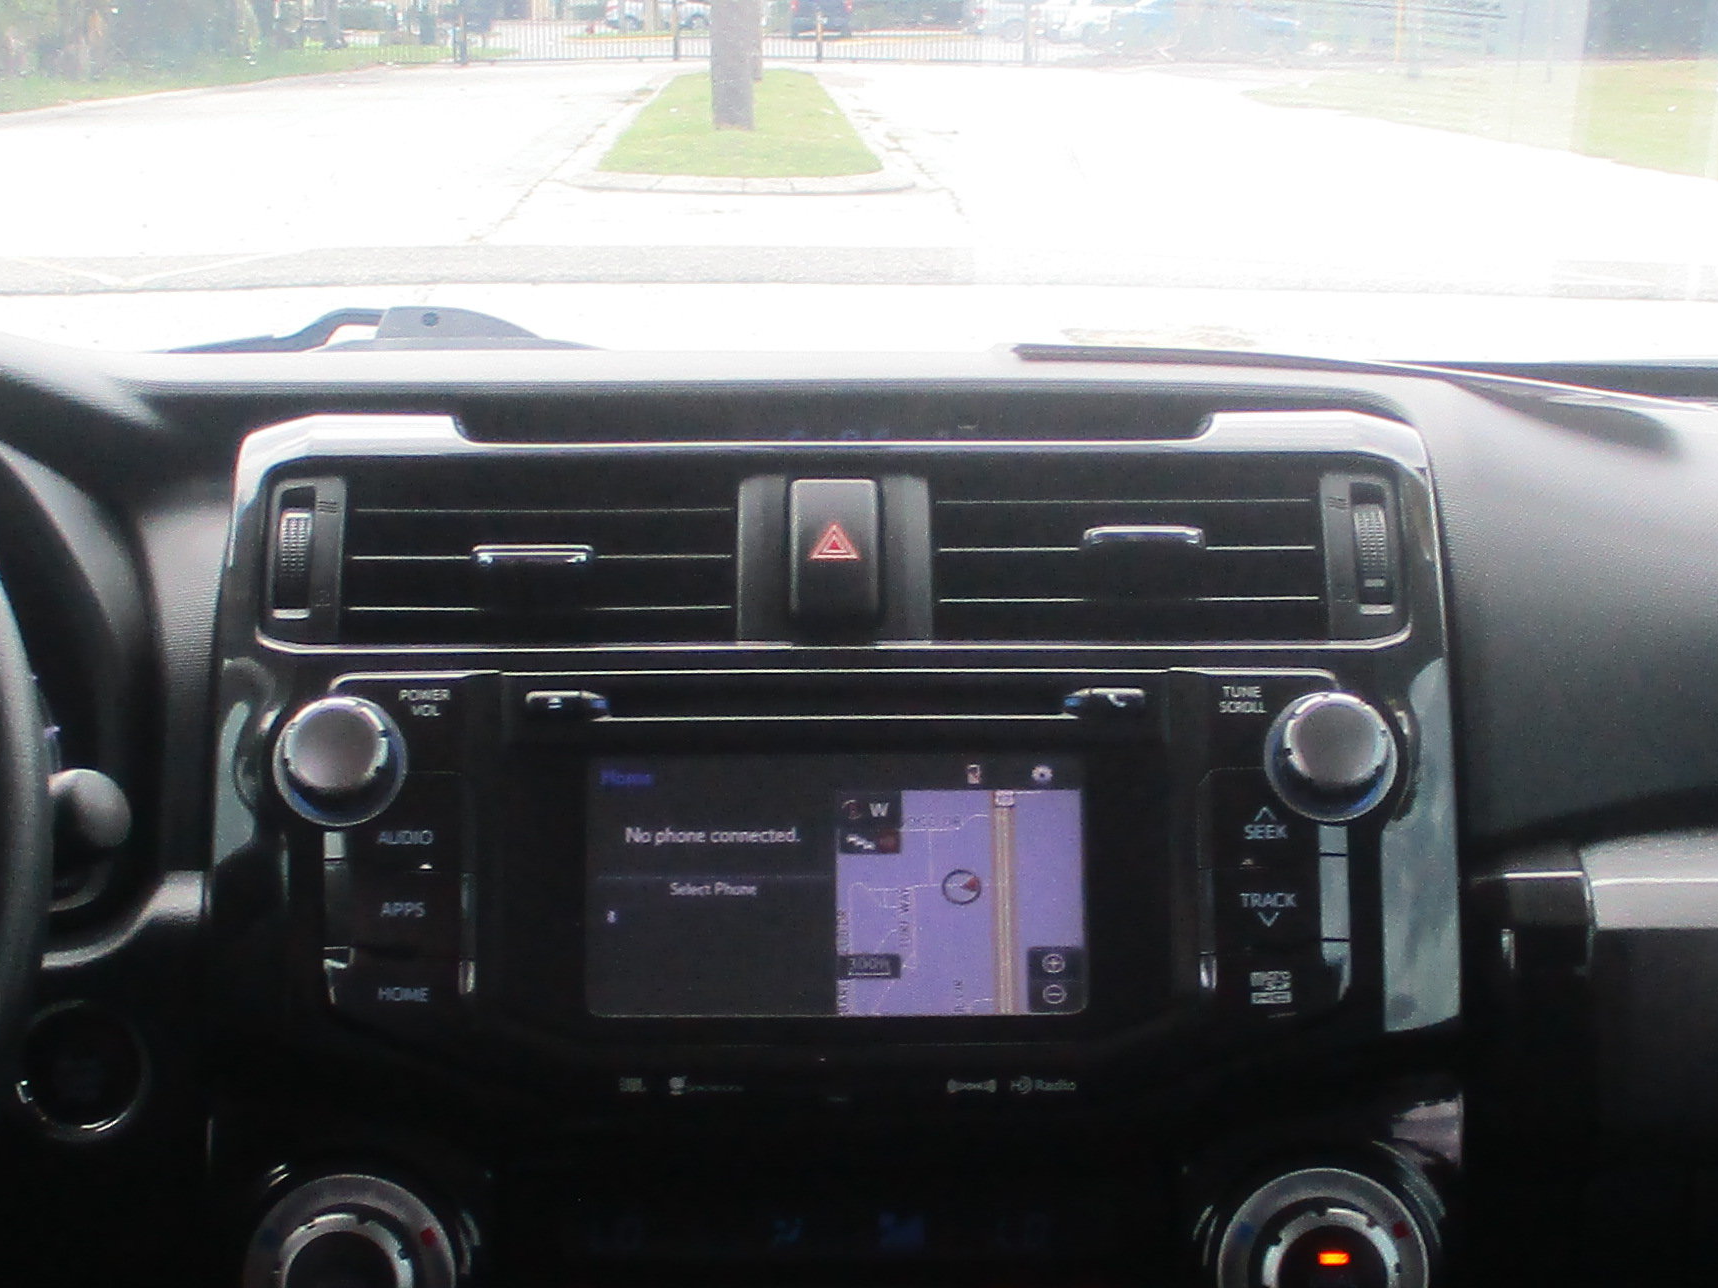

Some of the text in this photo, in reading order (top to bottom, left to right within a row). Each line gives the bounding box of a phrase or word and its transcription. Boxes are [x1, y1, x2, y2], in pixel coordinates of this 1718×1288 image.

[399, 689, 450, 701] POWER
[1222, 686, 1261, 697] TUNE
[411, 704, 441, 716] VOL
[1220, 700, 1266, 713] SCROLL
[869, 802, 889, 817] W
[377, 831, 434, 845] AUDIO
[625, 827, 801, 846] No phone connected.
[1244, 825, 1287, 839] SEEK
[670, 883, 757, 896] Select Phone
[1241, 893, 1296, 907] TRACK
[380, 903, 425, 918] APPS
[377, 987, 428, 1002] HOME
